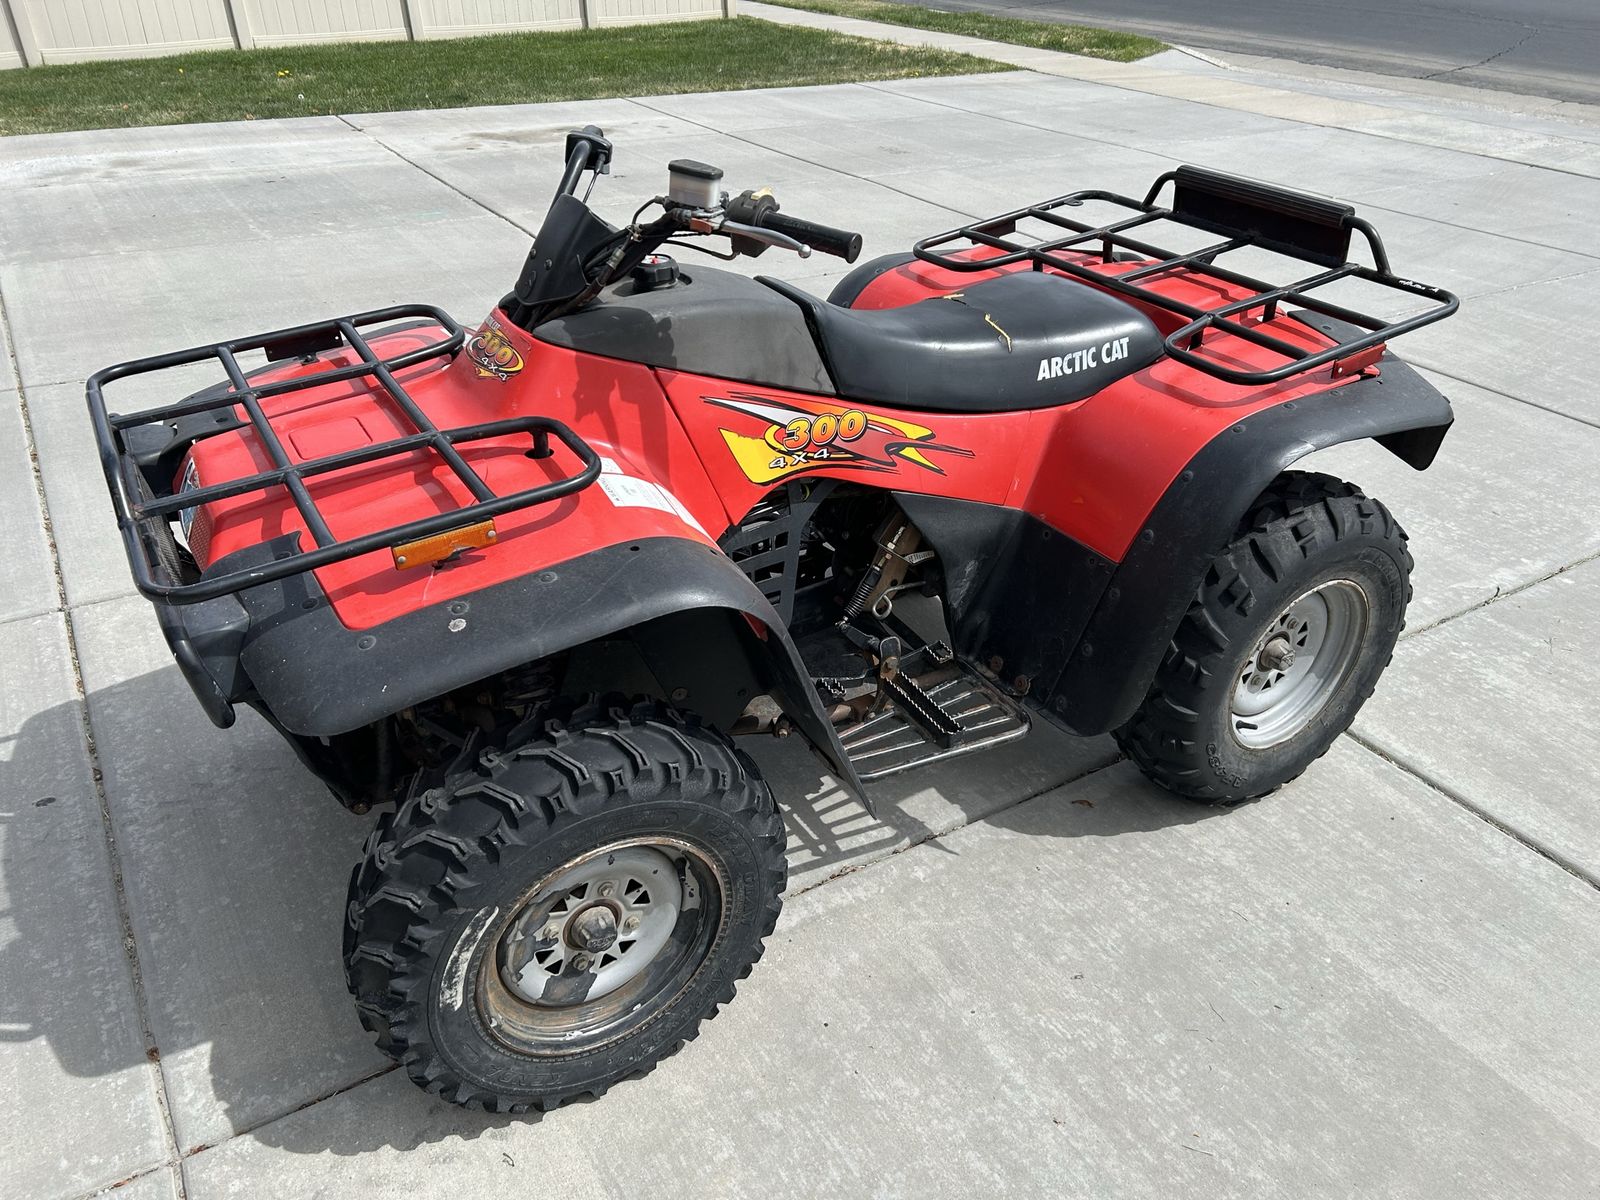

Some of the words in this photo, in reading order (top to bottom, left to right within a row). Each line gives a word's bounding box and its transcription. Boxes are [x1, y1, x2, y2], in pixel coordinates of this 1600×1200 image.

[478, 331, 514, 365] 300
[1036, 346, 1097, 382] ARCTIC
[1101, 336, 1130, 364] CAT
[783, 409, 868, 451] 300
